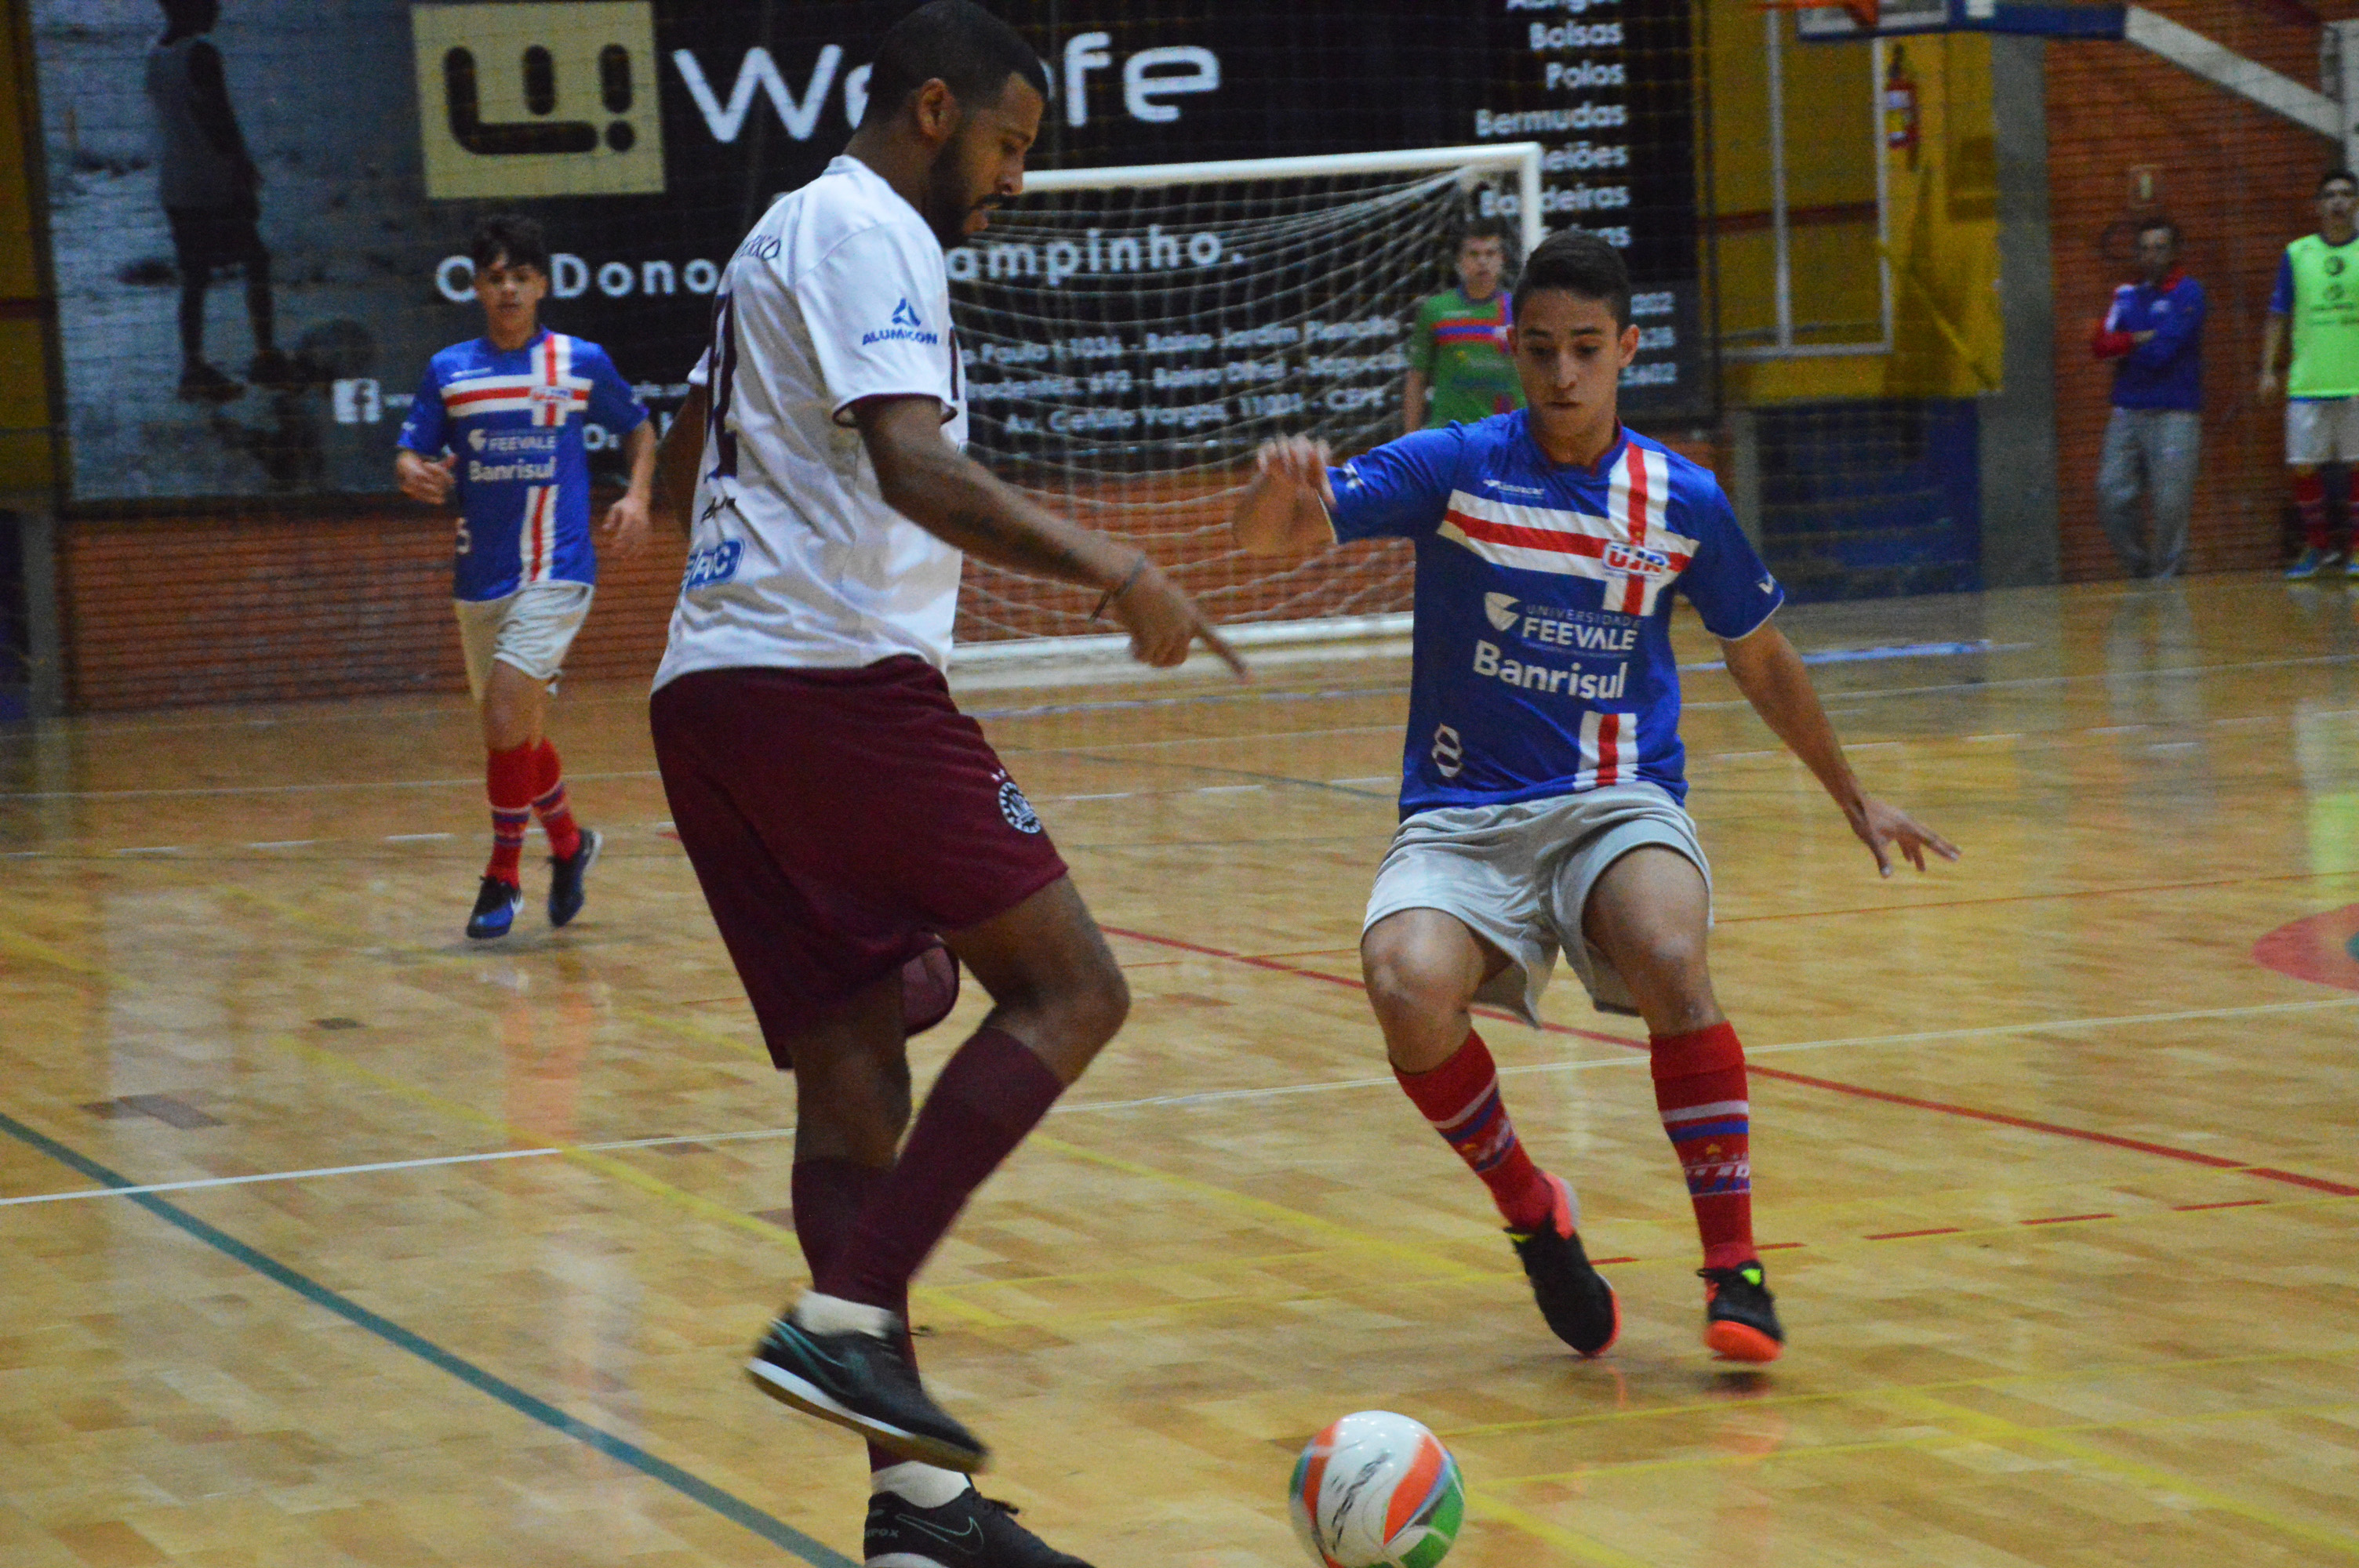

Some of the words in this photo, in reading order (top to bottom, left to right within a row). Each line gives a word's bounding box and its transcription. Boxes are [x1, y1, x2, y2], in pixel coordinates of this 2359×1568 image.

[1529, 20, 1623, 50] Bolsas
[1474, 101, 1627, 137] Bermudas
[1480, 183, 1630, 218] Badeiras
[551, 252, 720, 299] Dono
[943, 223, 1244, 287] ampinho.
[468, 456, 557, 482] Banrisul
[1522, 617, 1638, 651] FEEVALE
[1525, 604, 1644, 630] UNIVERSIDADE
[1472, 639, 1628, 700] Banrisul
